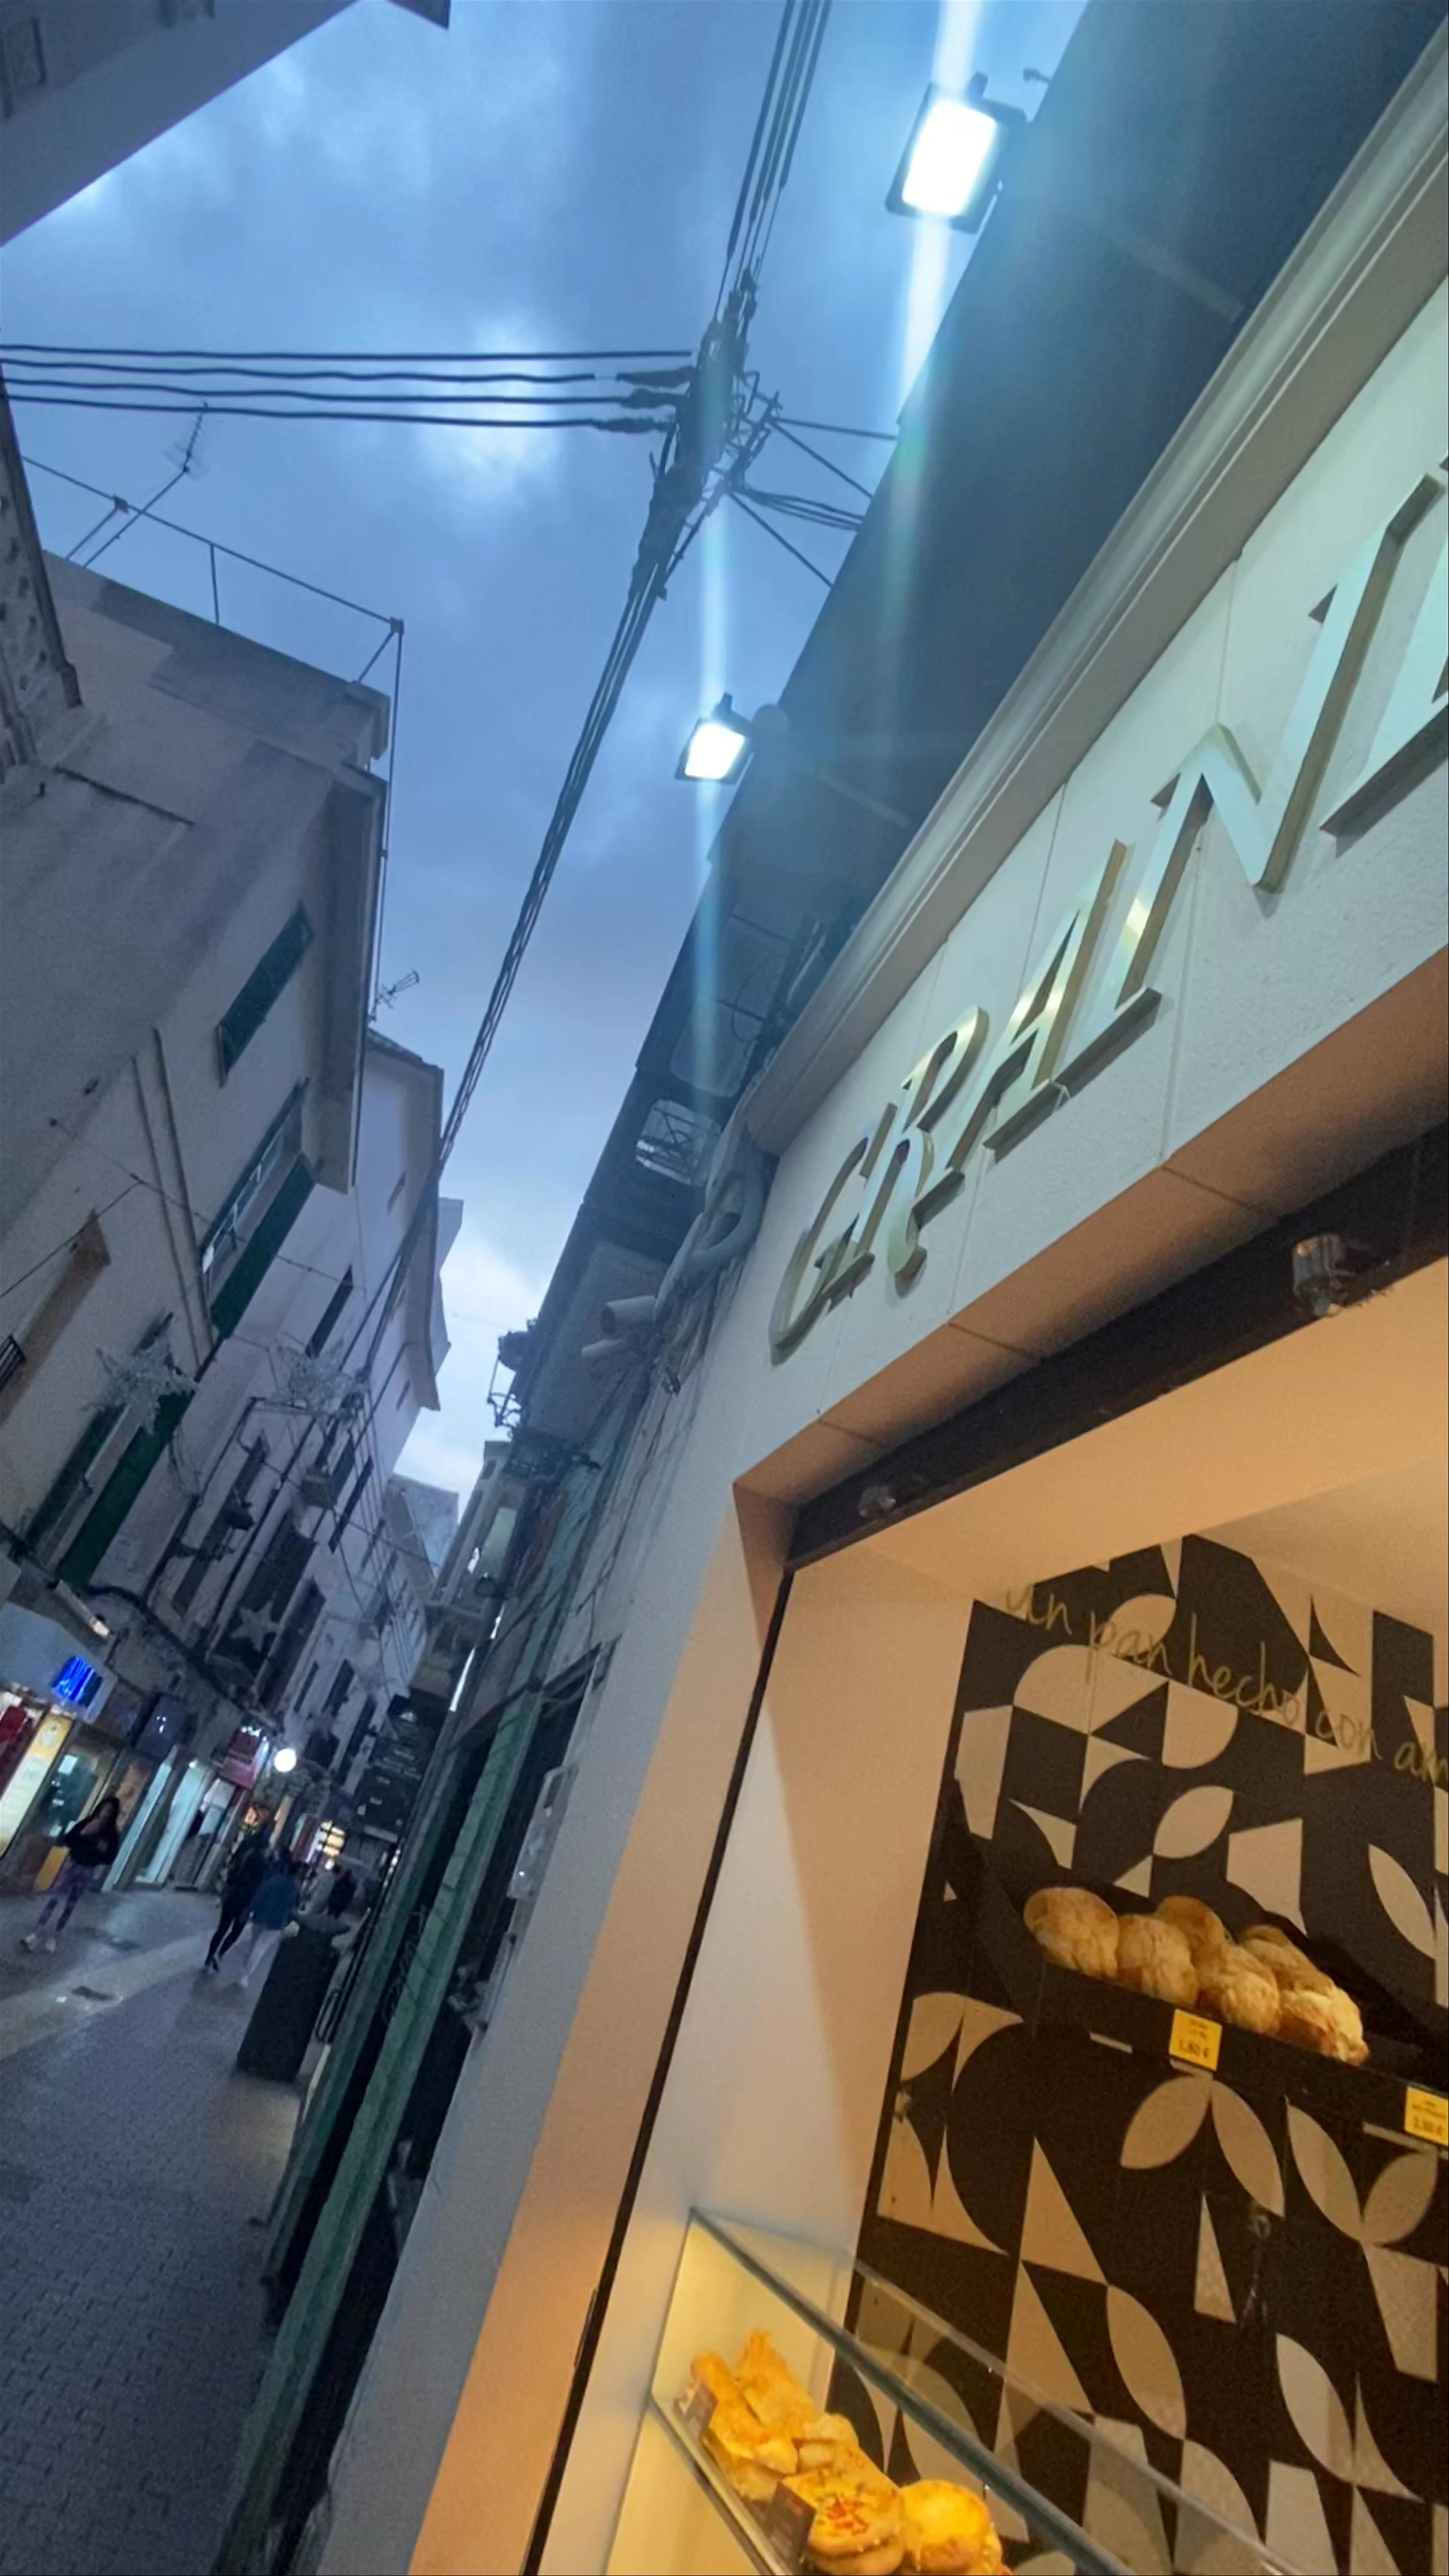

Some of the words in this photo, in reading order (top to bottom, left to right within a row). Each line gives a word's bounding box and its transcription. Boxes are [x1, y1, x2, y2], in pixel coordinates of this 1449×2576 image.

[1084, 1610, 1172, 1684] pan
[1188, 1612, 1300, 1727] hecho
[1315, 1708, 1383, 1761] con
